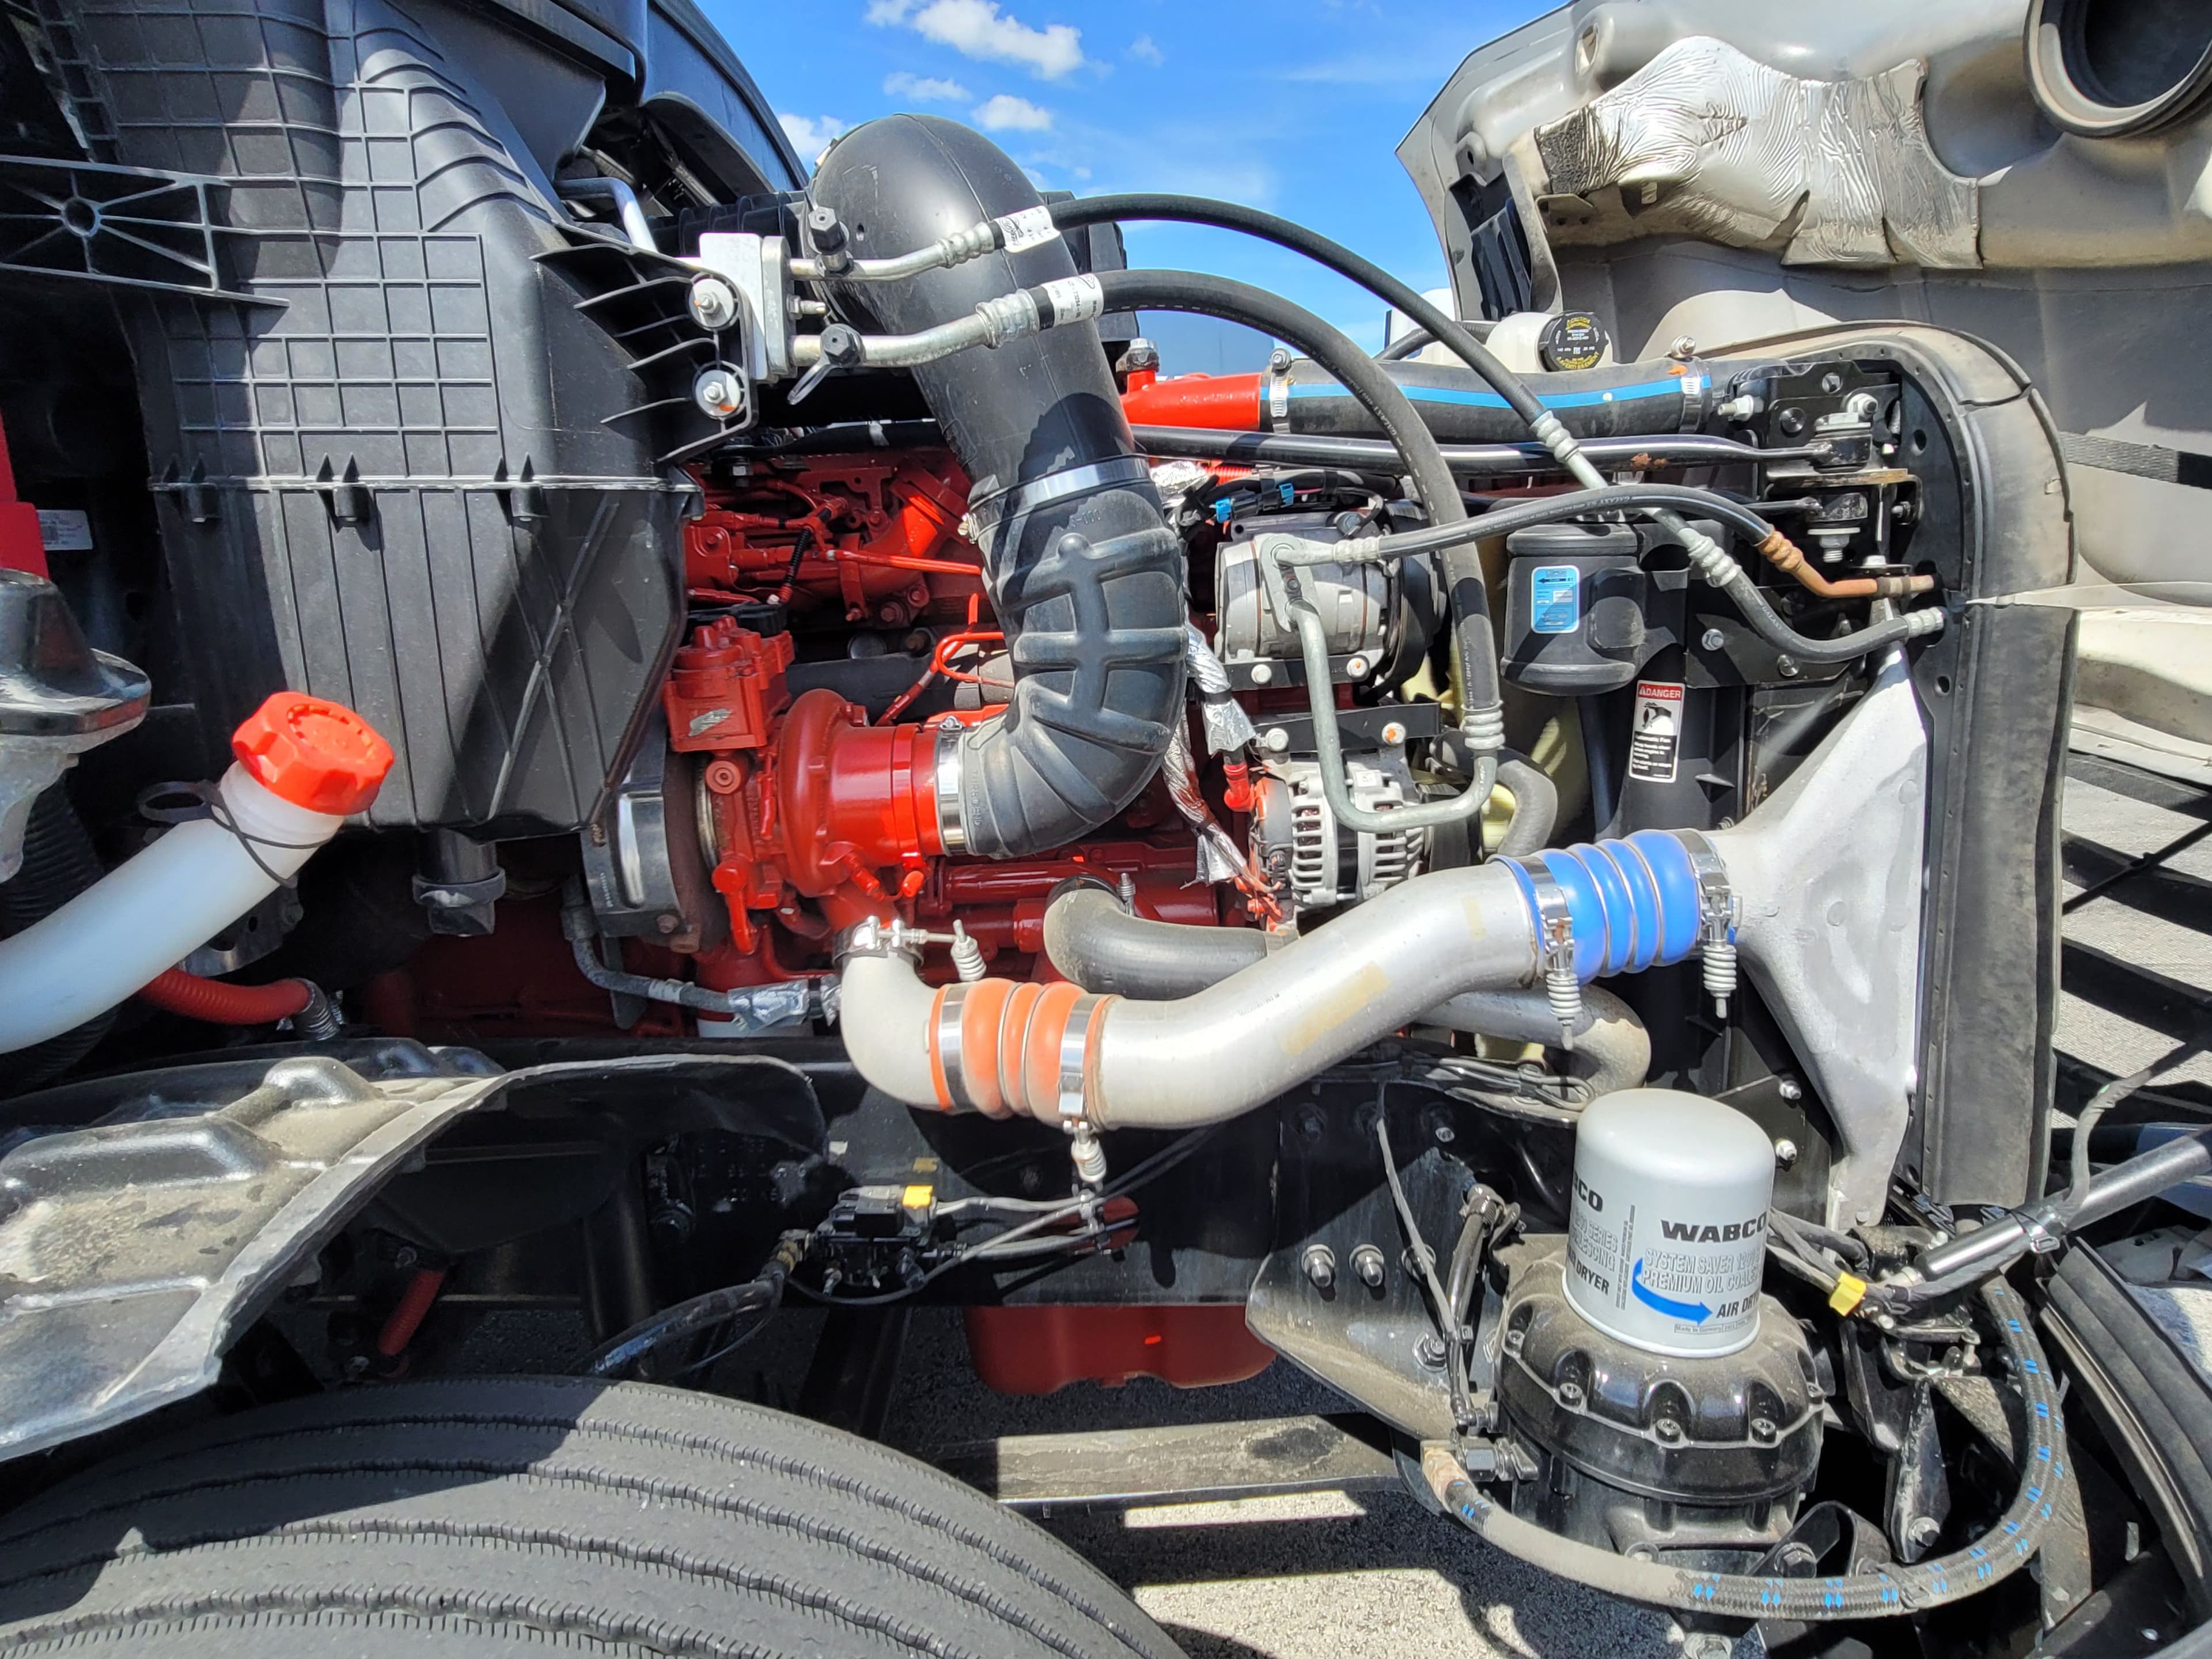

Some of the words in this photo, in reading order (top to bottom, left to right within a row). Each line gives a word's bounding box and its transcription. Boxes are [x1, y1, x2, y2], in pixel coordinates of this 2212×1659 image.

[1373, 406, 1397, 436] GALAXY
[1600, 495, 1630, 505] GALAXY
[1645, 688, 1681, 699] DANGER
[1661, 1211, 1767, 1243] WABCO
[1645, 1248, 1696, 1274] SYSTEM
[1698, 1254, 1734, 1275] SAVER
[1576, 1258, 1610, 1296] DRYER
[1642, 1268, 1703, 1294] PREMIUM
[1705, 1275, 1724, 1294] OIL
[1716, 1300, 1739, 1319] AIR
